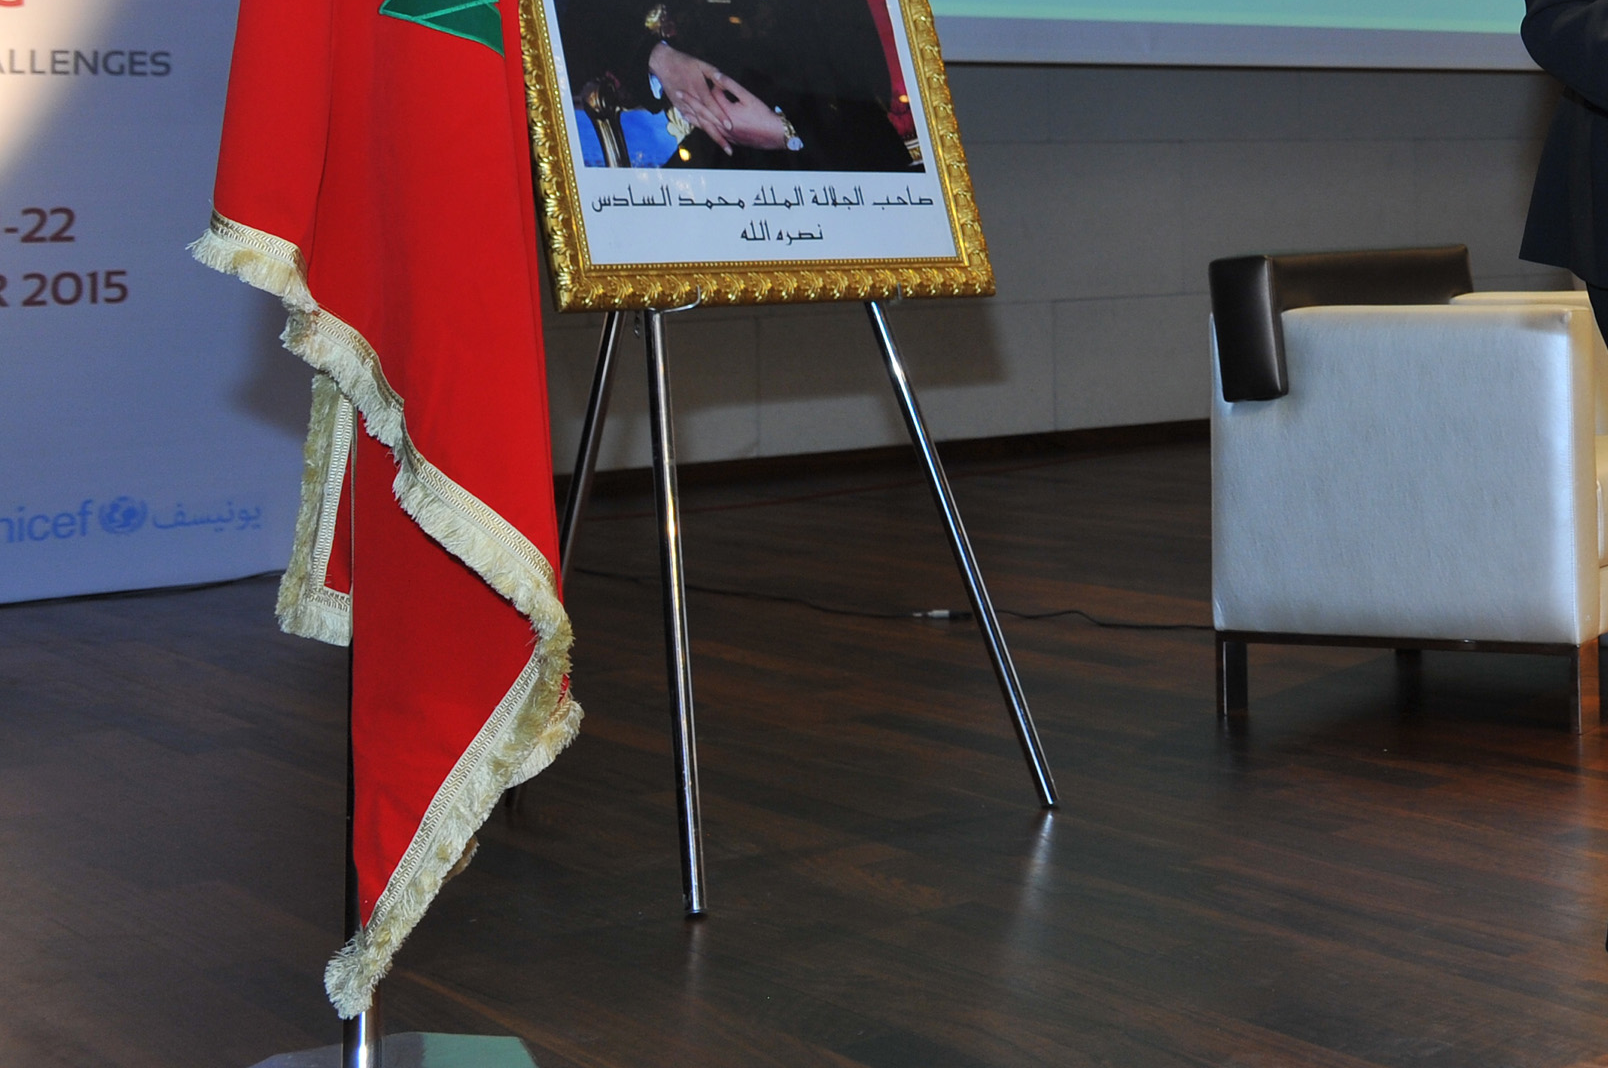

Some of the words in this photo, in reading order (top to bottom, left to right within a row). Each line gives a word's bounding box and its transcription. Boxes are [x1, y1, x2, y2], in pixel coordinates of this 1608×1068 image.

[590, 184, 673, 213] السادس
[677, 189, 747, 209] محمد
[750, 185, 805, 209] الملك
[810, 185, 865, 211] الجلالة
[871, 186, 935, 211] صاحب
[739, 220, 771, 242] الله
[775, 223, 825, 246] نصره
[21, 270, 129, 307] 2015
[152, 499, 262, 534] يونيسف
